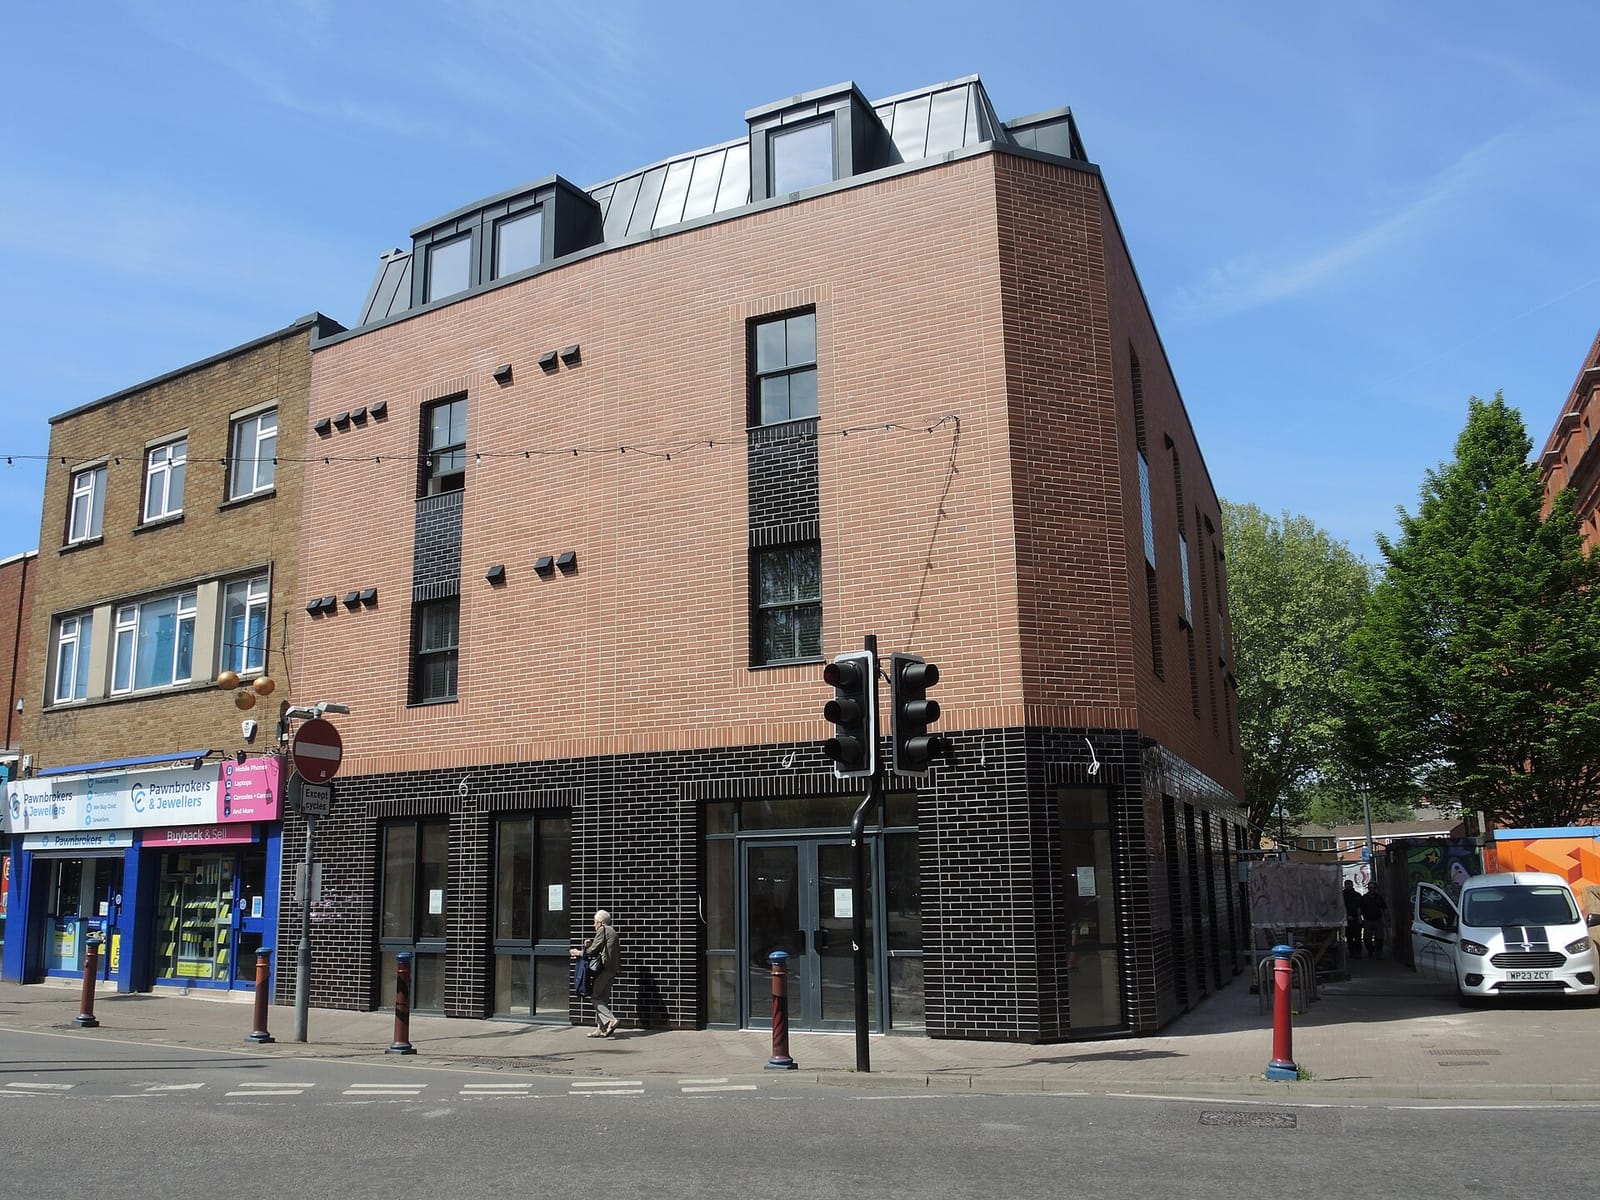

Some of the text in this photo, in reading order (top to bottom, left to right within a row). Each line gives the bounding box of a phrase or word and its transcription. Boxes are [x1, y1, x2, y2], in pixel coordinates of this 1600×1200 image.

[150, 780, 210, 795] Pawnbrokers
[24, 791, 73, 804] Pawnbrokers
[305, 789, 328, 800] Except
[149, 795, 202, 809] & Jewellers
[29, 804, 66, 817] Jewellers
[55, 834, 103, 846] Pawnbrokers
[167, 826, 227, 844] Buyback & Sell
[1510, 971, 1550, 980] WP23 ZCY
